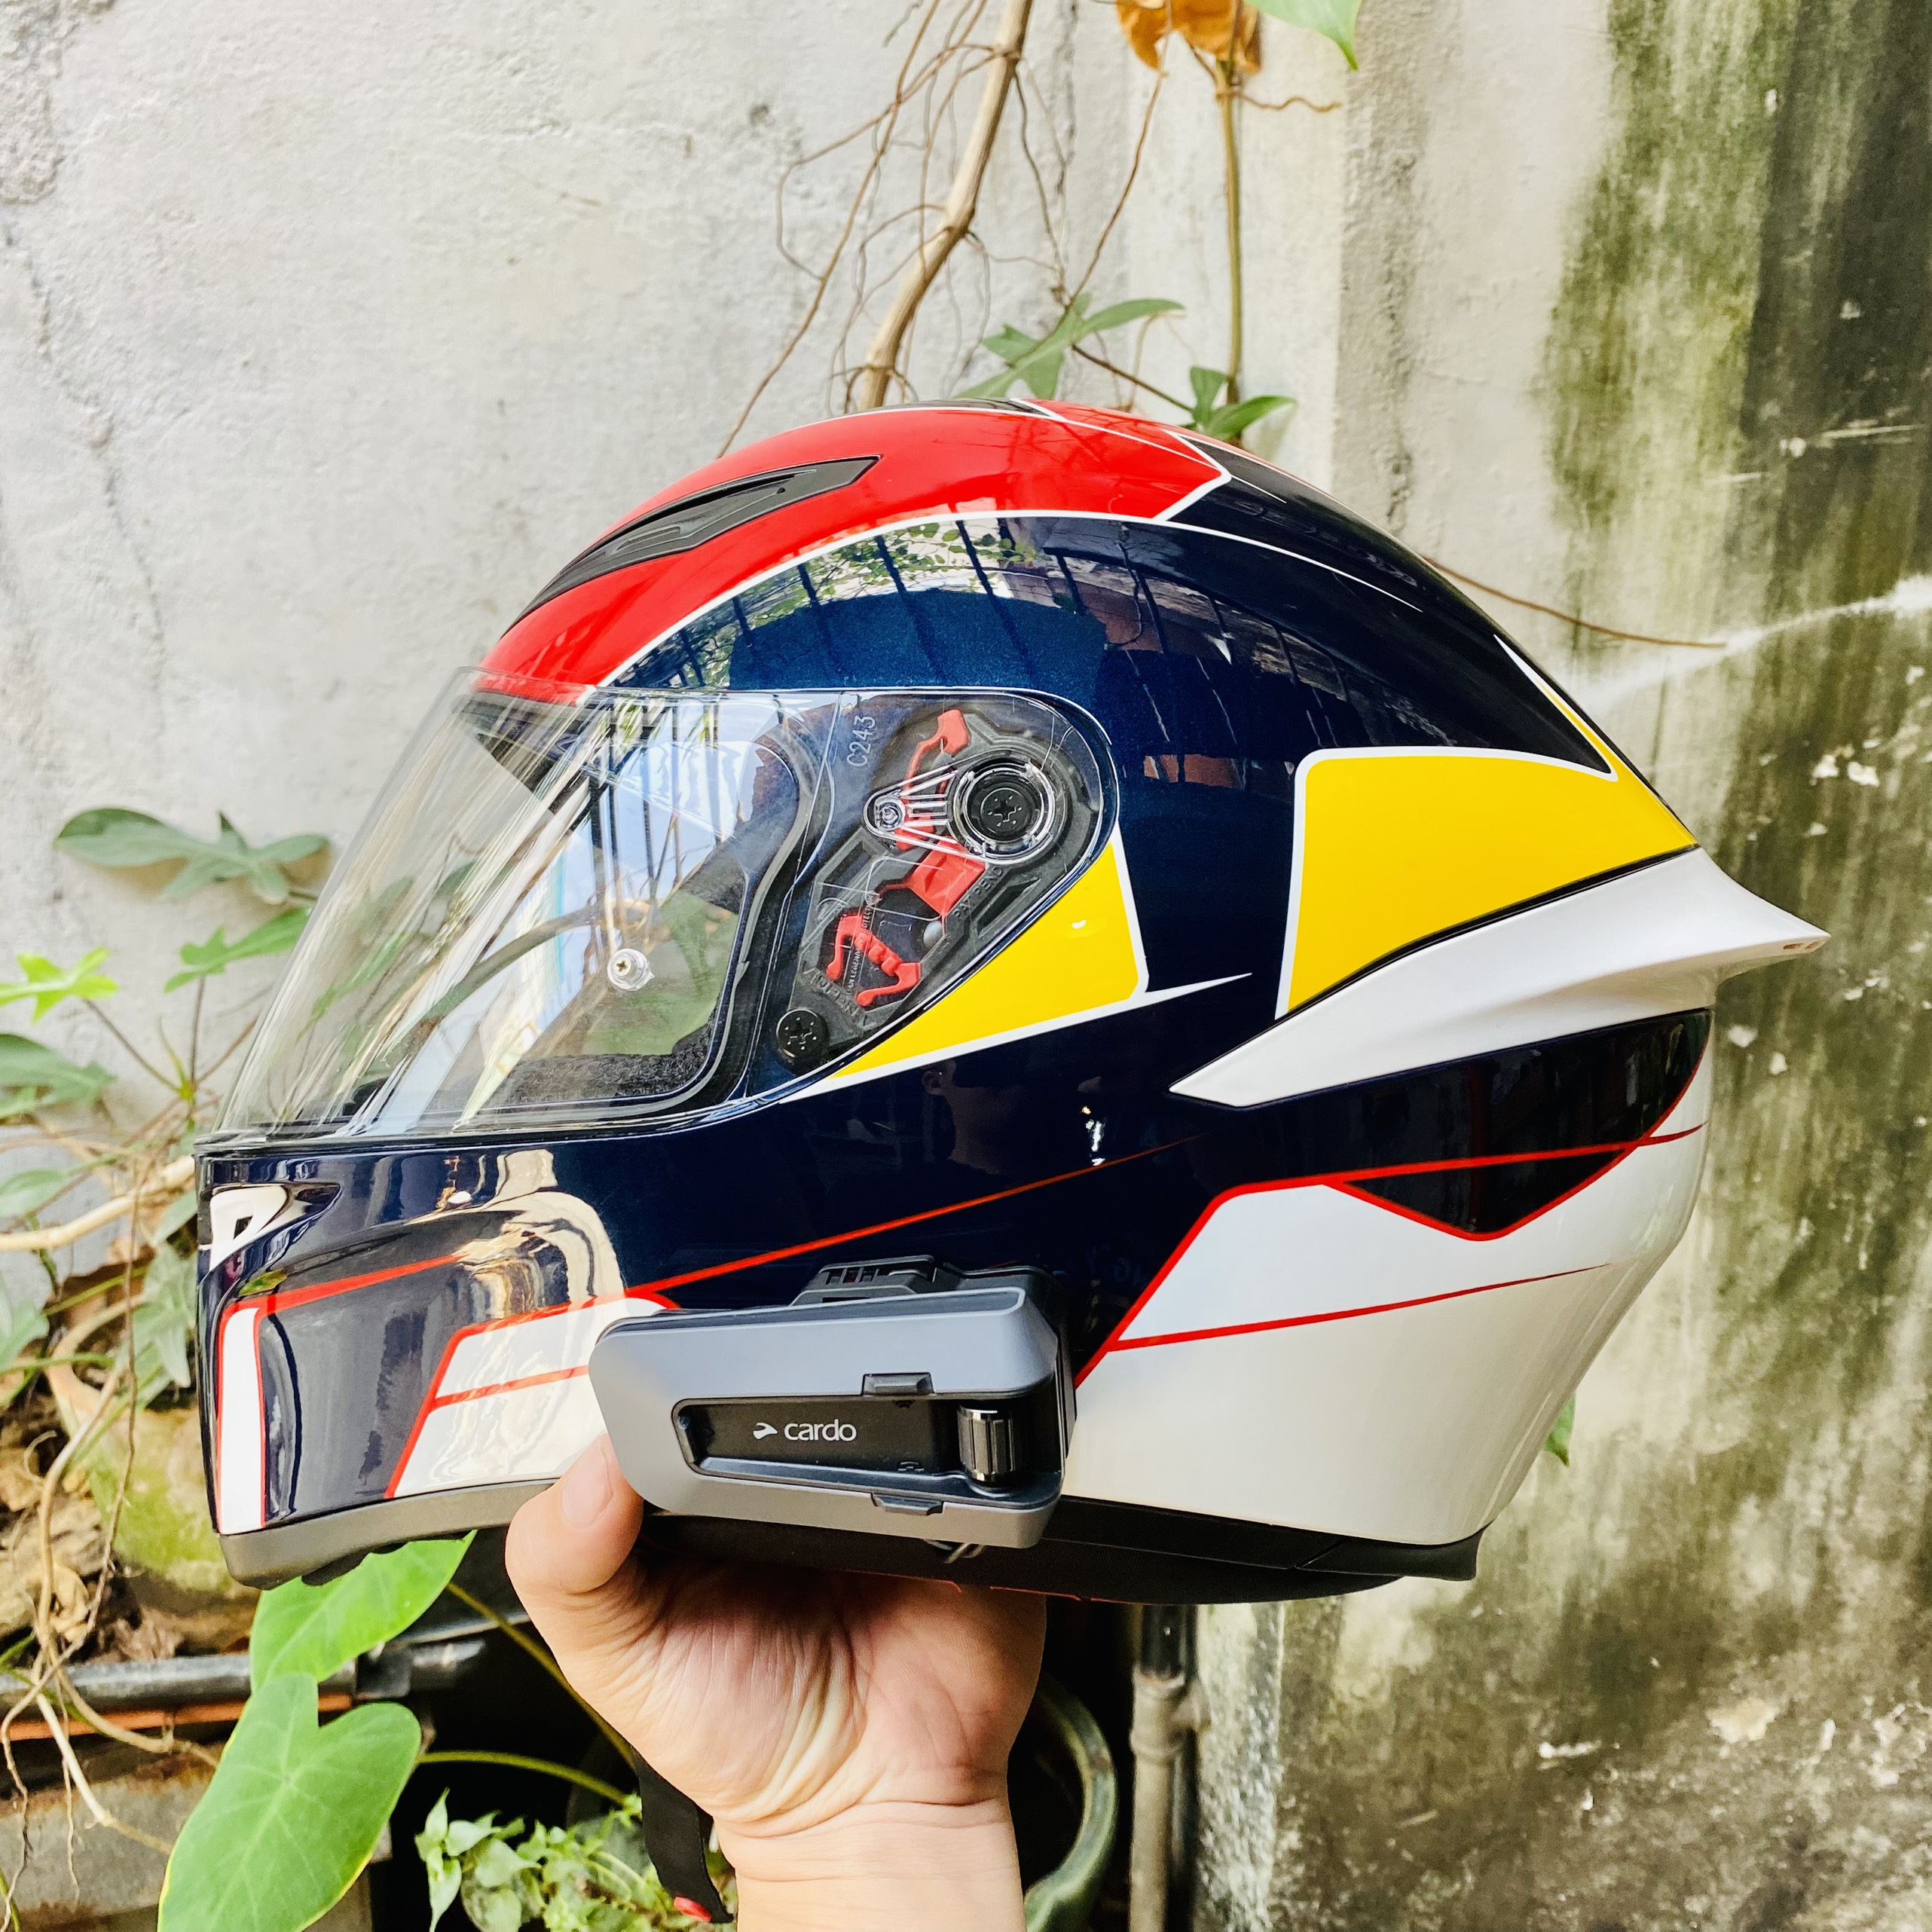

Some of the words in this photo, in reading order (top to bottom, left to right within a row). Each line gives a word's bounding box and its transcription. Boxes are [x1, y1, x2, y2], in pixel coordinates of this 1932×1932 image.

[846, 715, 876, 767] C243
[971, 864, 1004, 898] PEND
[784, 1418, 857, 1441] cardo
